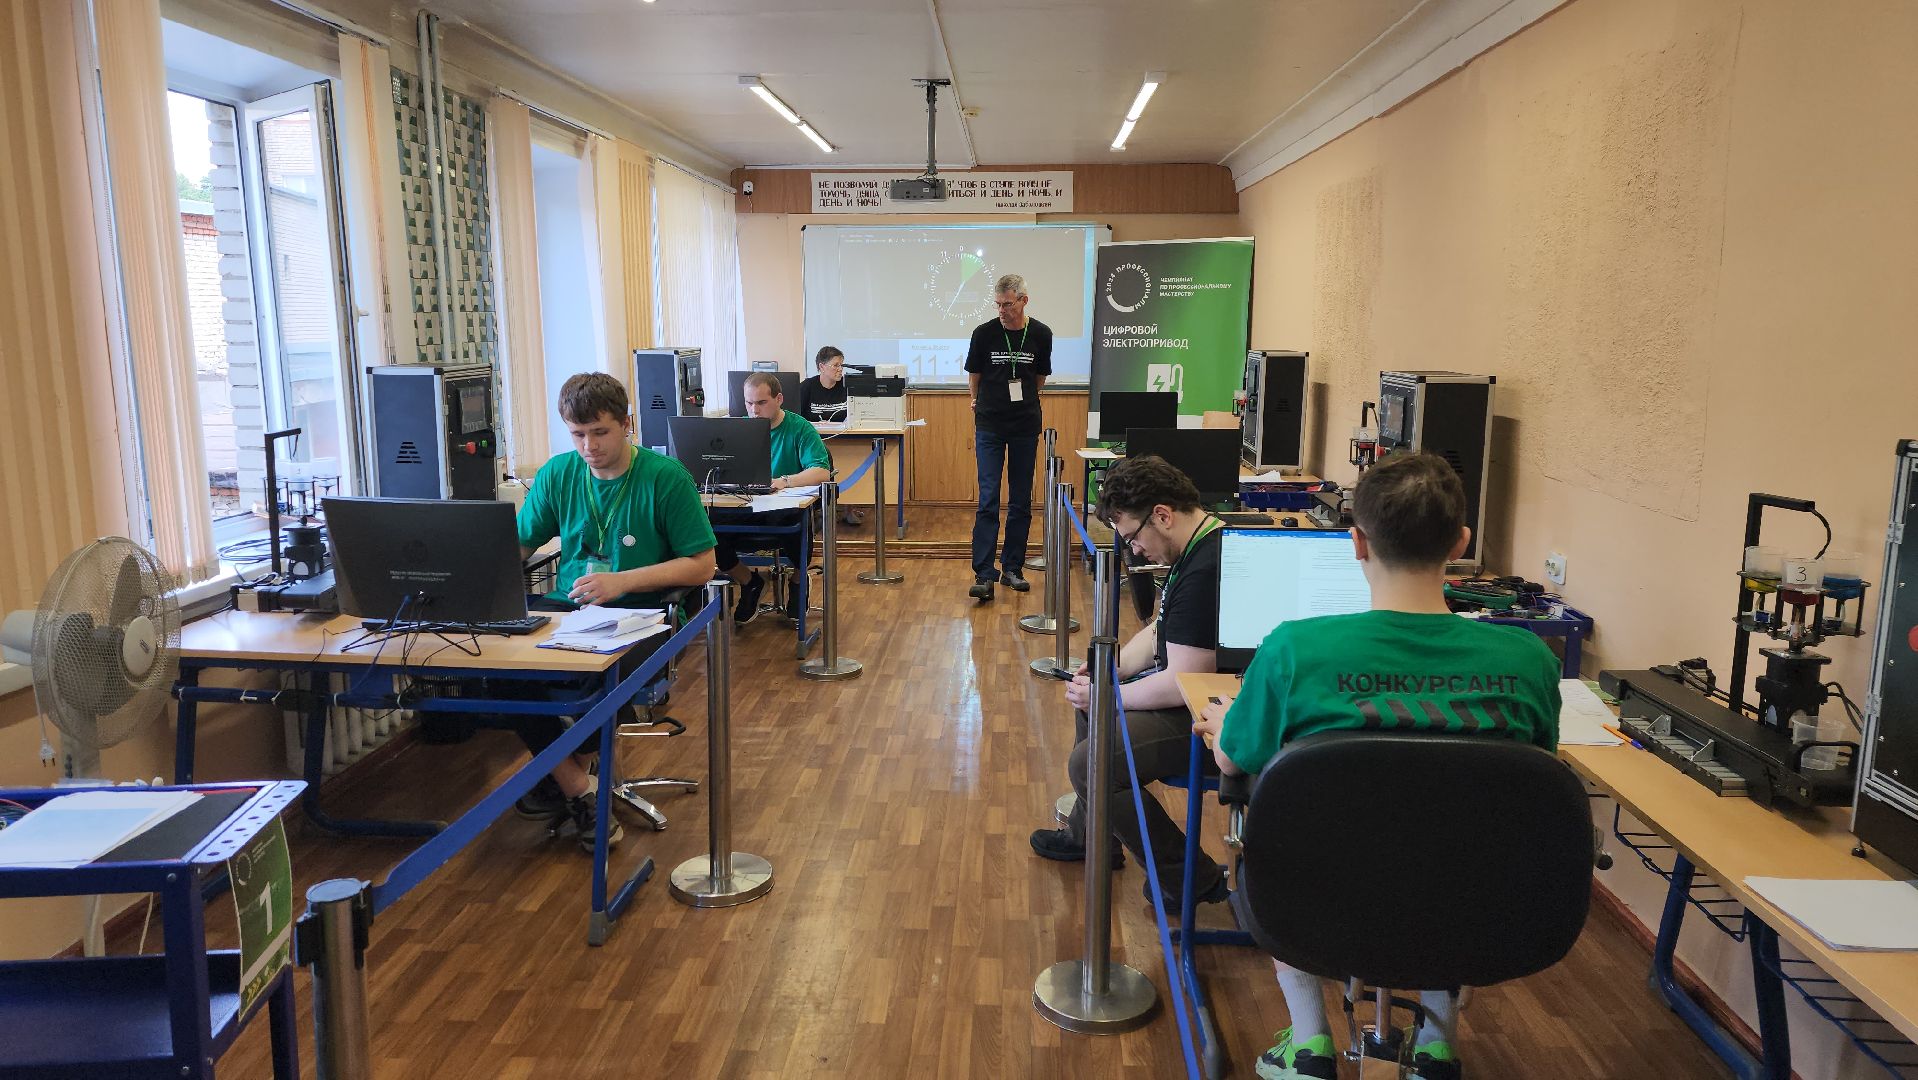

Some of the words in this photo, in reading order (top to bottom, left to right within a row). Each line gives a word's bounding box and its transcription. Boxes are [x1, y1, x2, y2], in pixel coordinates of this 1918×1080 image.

[958, 180, 978, 188] ЧТОБ
[980, 180, 987, 188] В
[948, 189, 977, 198] ИТЬСЯ
[980, 189, 987, 198] И
[990, 189, 1014, 198] ДЕНЬ
[1017, 189, 1025, 198] И
[1055, 189, 1063, 197] И
[819, 198, 843, 207] ДЕНЬ
[846, 198, 853, 207] И
[1103, 323, 1158, 337] ЦИФРОВОЙ
[1102, 338, 1189, 350] ЭЛЕКТРОПРИВОД
[1795, 566, 1807, 582] 3
[1337, 672, 1519, 694] КОНКУРСАНТ
[259, 881, 273, 935] 1
